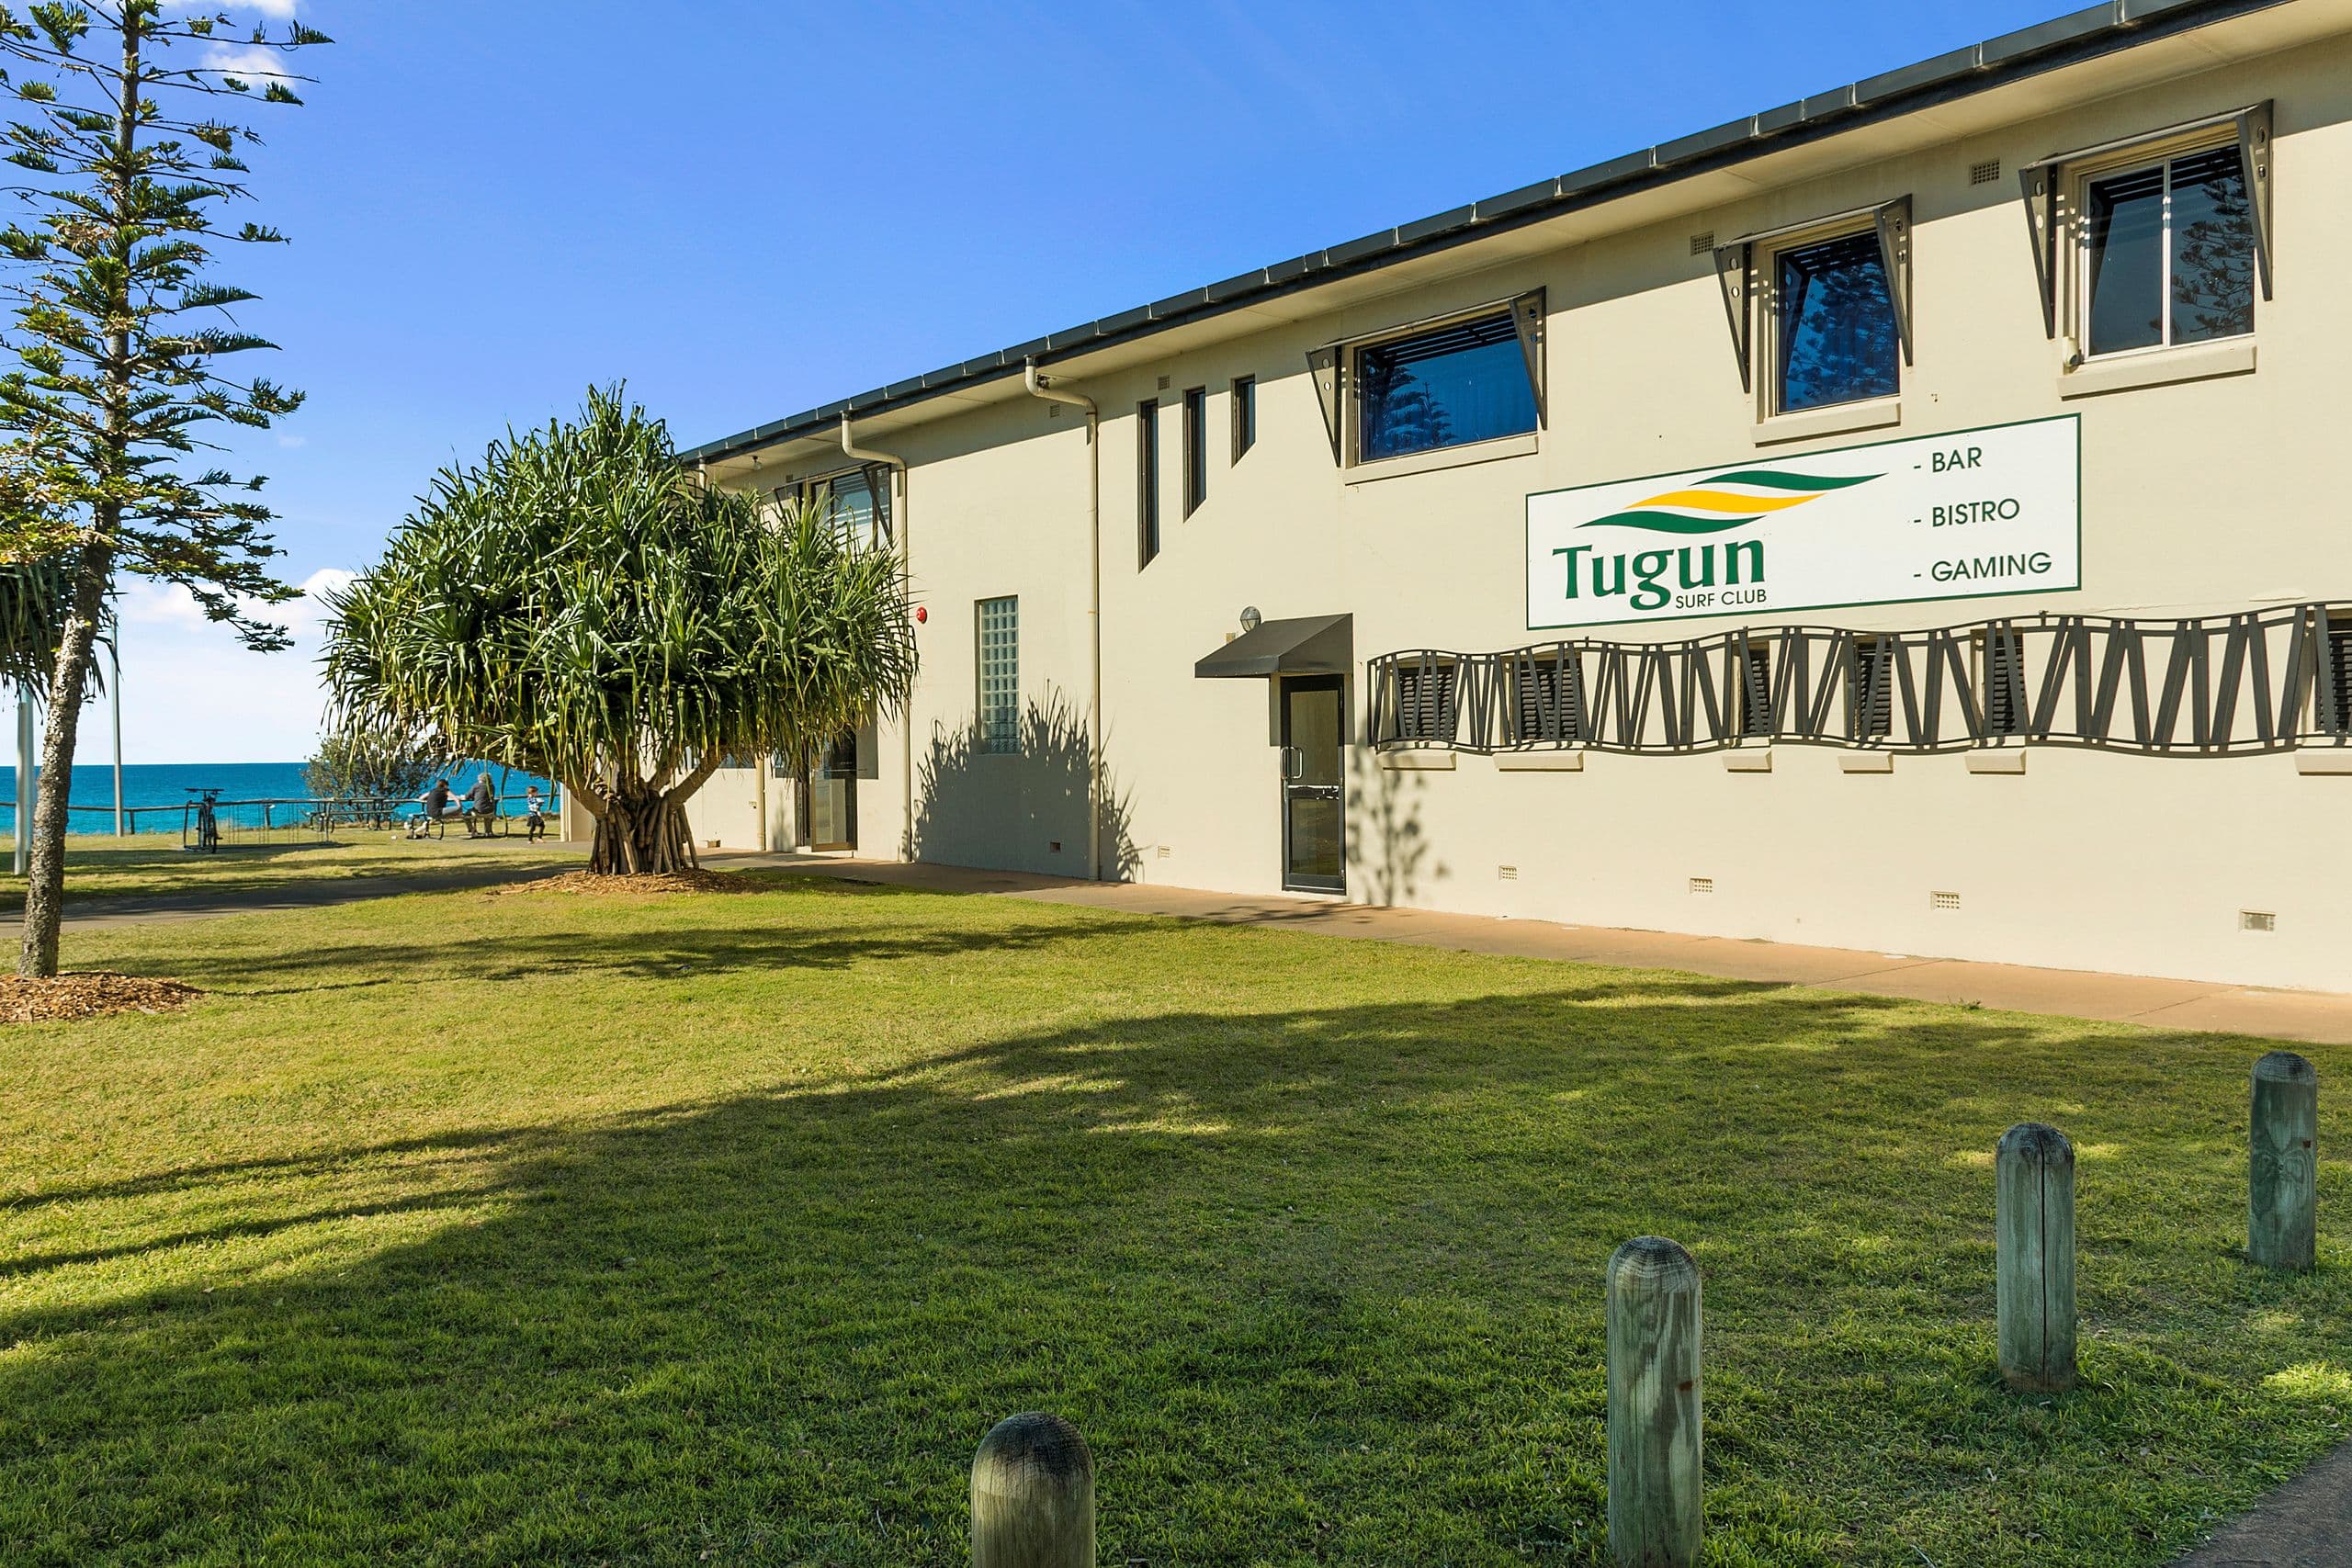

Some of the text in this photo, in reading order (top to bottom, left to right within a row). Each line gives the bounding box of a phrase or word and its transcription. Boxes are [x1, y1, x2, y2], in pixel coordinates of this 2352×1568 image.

[1932, 446, 1983, 473] BAR
[1932, 498, 2020, 527] BISTRO
[1552, 538, 1766, 611] Tugun
[1931, 551, 2052, 582] GAMING
[1675, 589, 1767, 610] SURF CLUB
